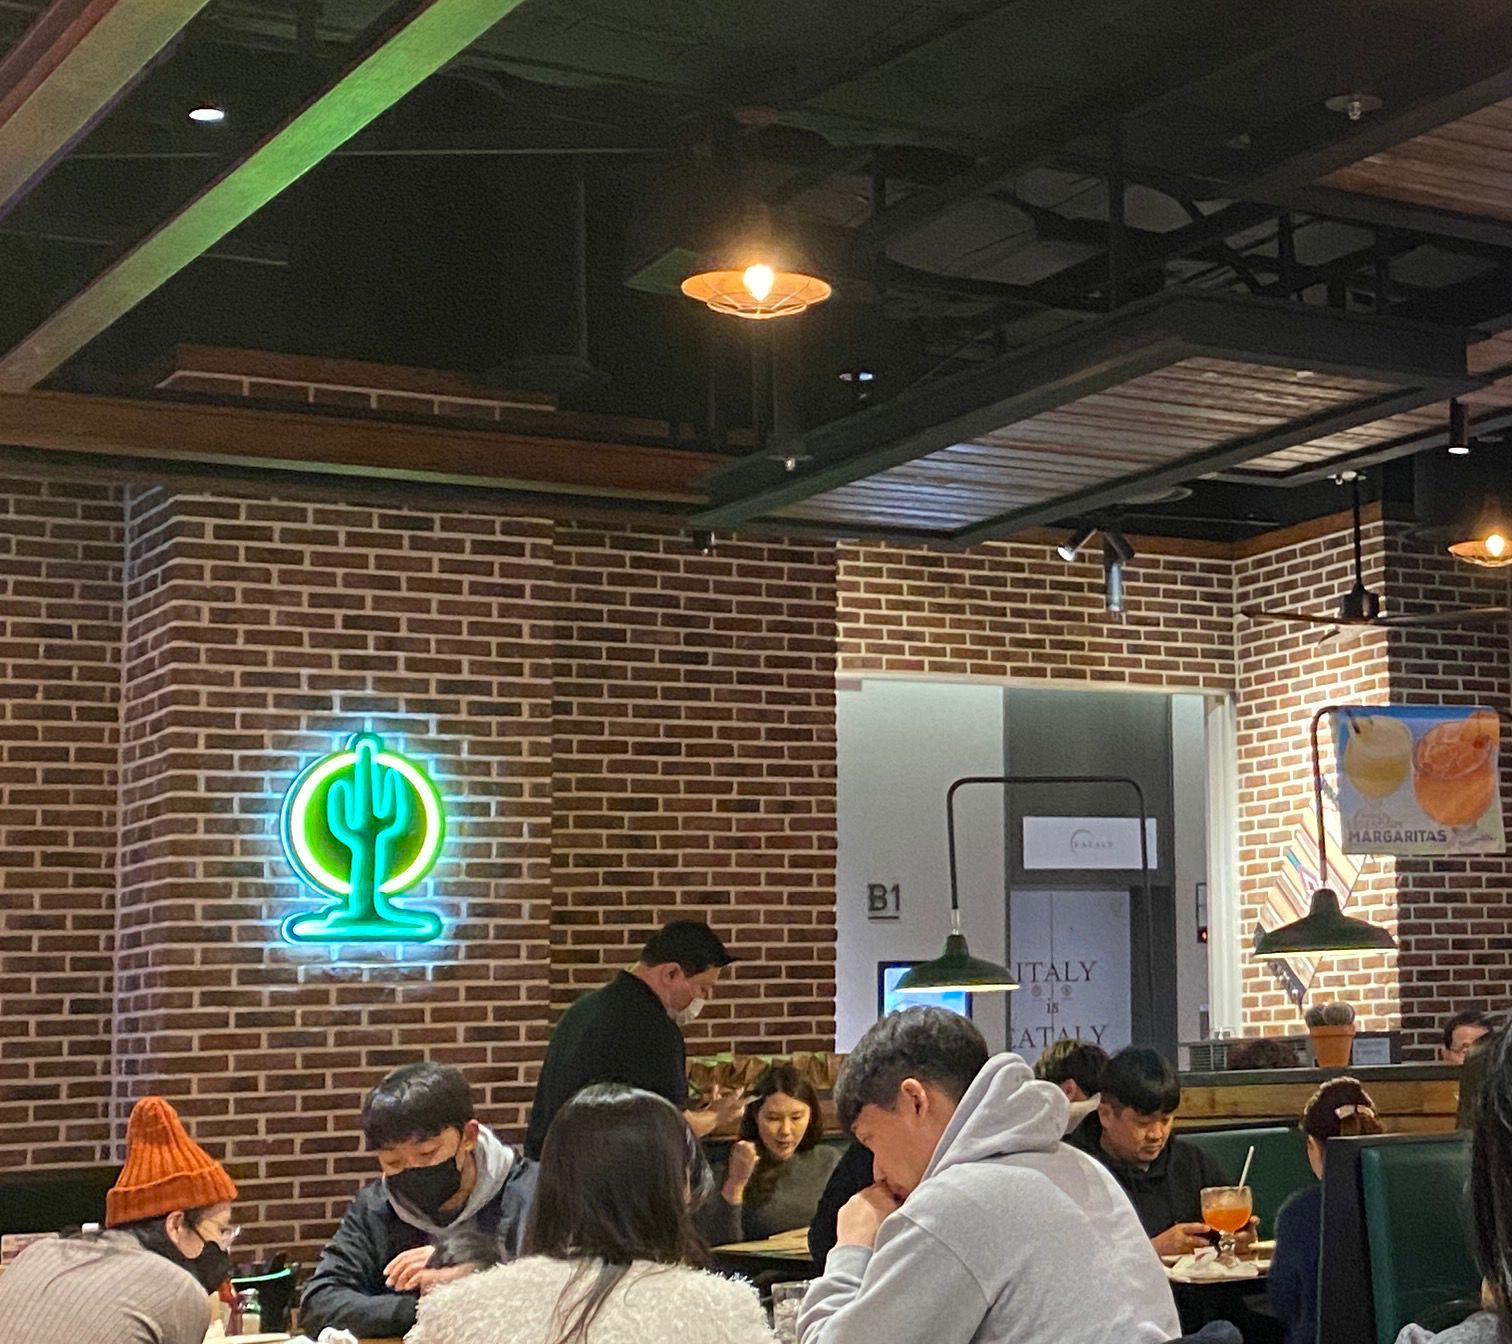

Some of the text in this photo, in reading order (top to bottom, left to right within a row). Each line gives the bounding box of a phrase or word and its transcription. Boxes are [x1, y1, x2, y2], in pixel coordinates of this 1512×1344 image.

[1349, 829, 1447, 844] MARGARITAS
[867, 882, 900, 912] B1
[1017, 961, 1097, 983] ITALY
[1011, 1024, 1106, 1049] ATAY
